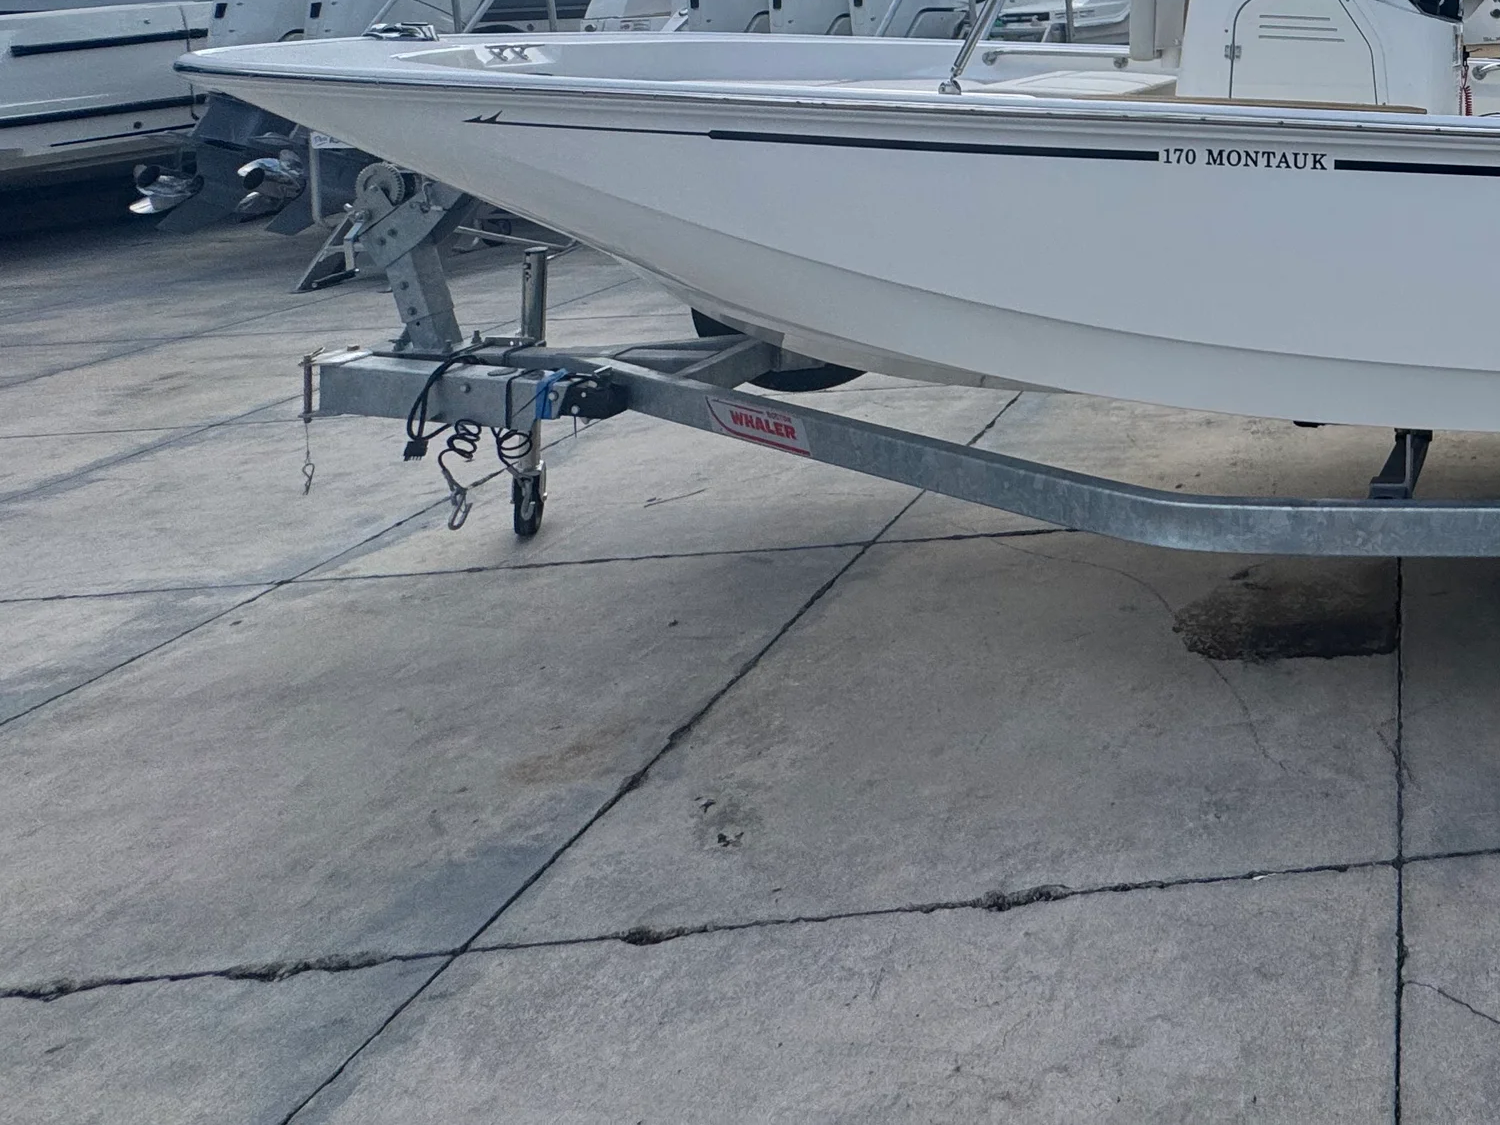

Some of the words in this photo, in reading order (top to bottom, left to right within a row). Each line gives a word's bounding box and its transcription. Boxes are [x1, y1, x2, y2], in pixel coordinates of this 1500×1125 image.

[1163, 148, 1197, 165] 170
[1205, 149, 1328, 171] MONTAUK
[730, 410, 797, 440] WHALER
